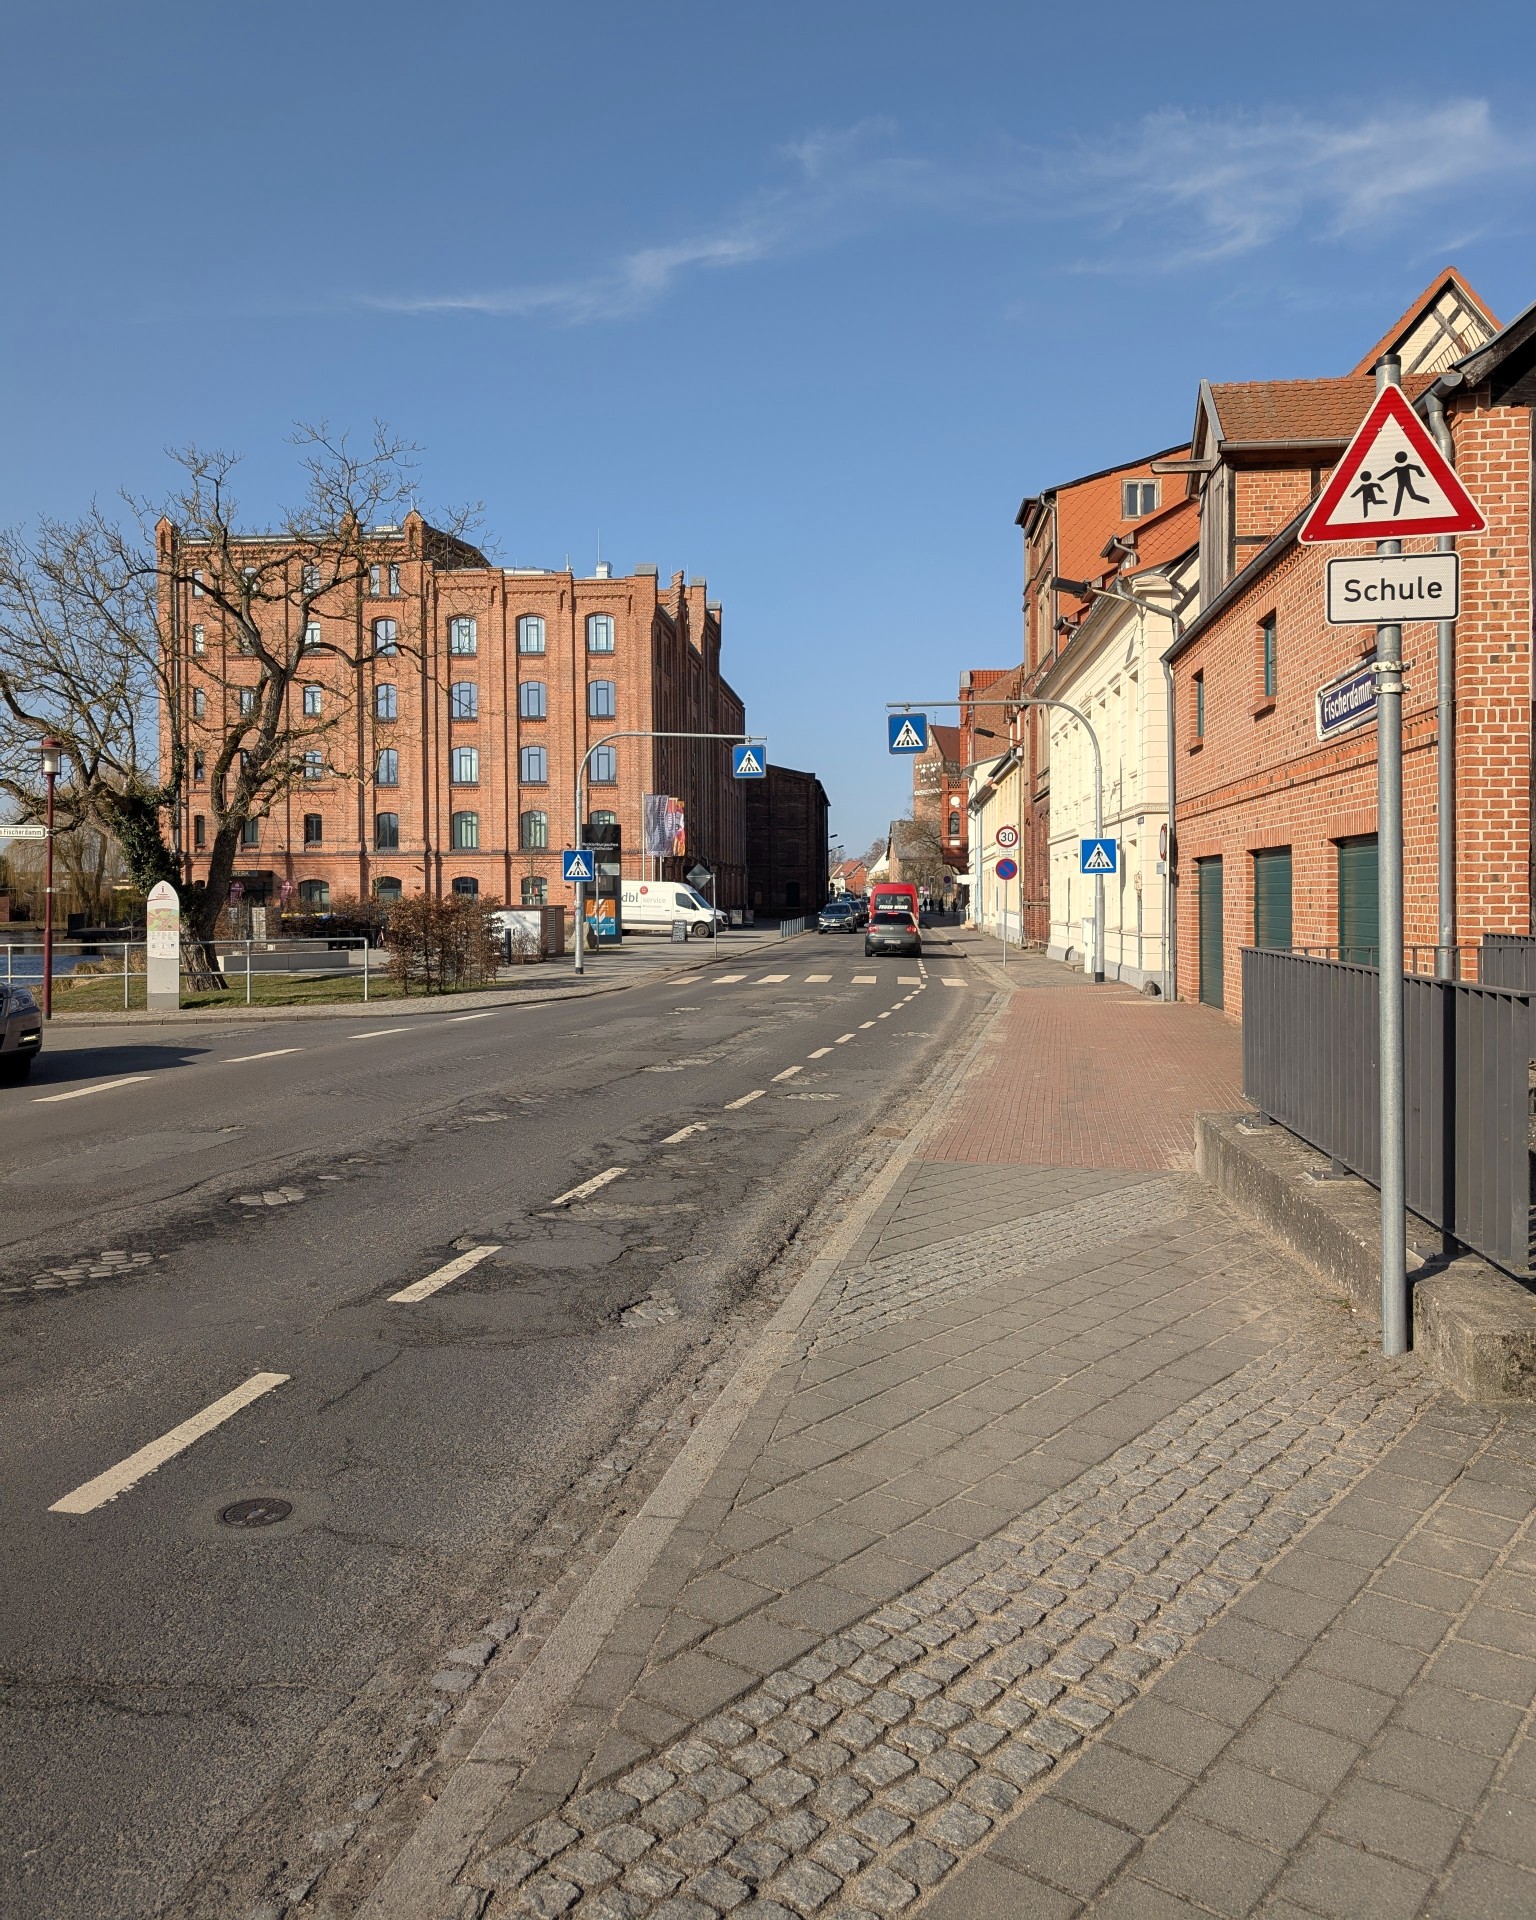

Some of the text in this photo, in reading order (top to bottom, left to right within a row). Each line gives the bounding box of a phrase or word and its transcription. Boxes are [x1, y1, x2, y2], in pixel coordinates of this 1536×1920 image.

[1343, 576, 1443, 602] Schule
[1000, 831, 1014, 842] 30
[621, 892, 639, 902] dbl
